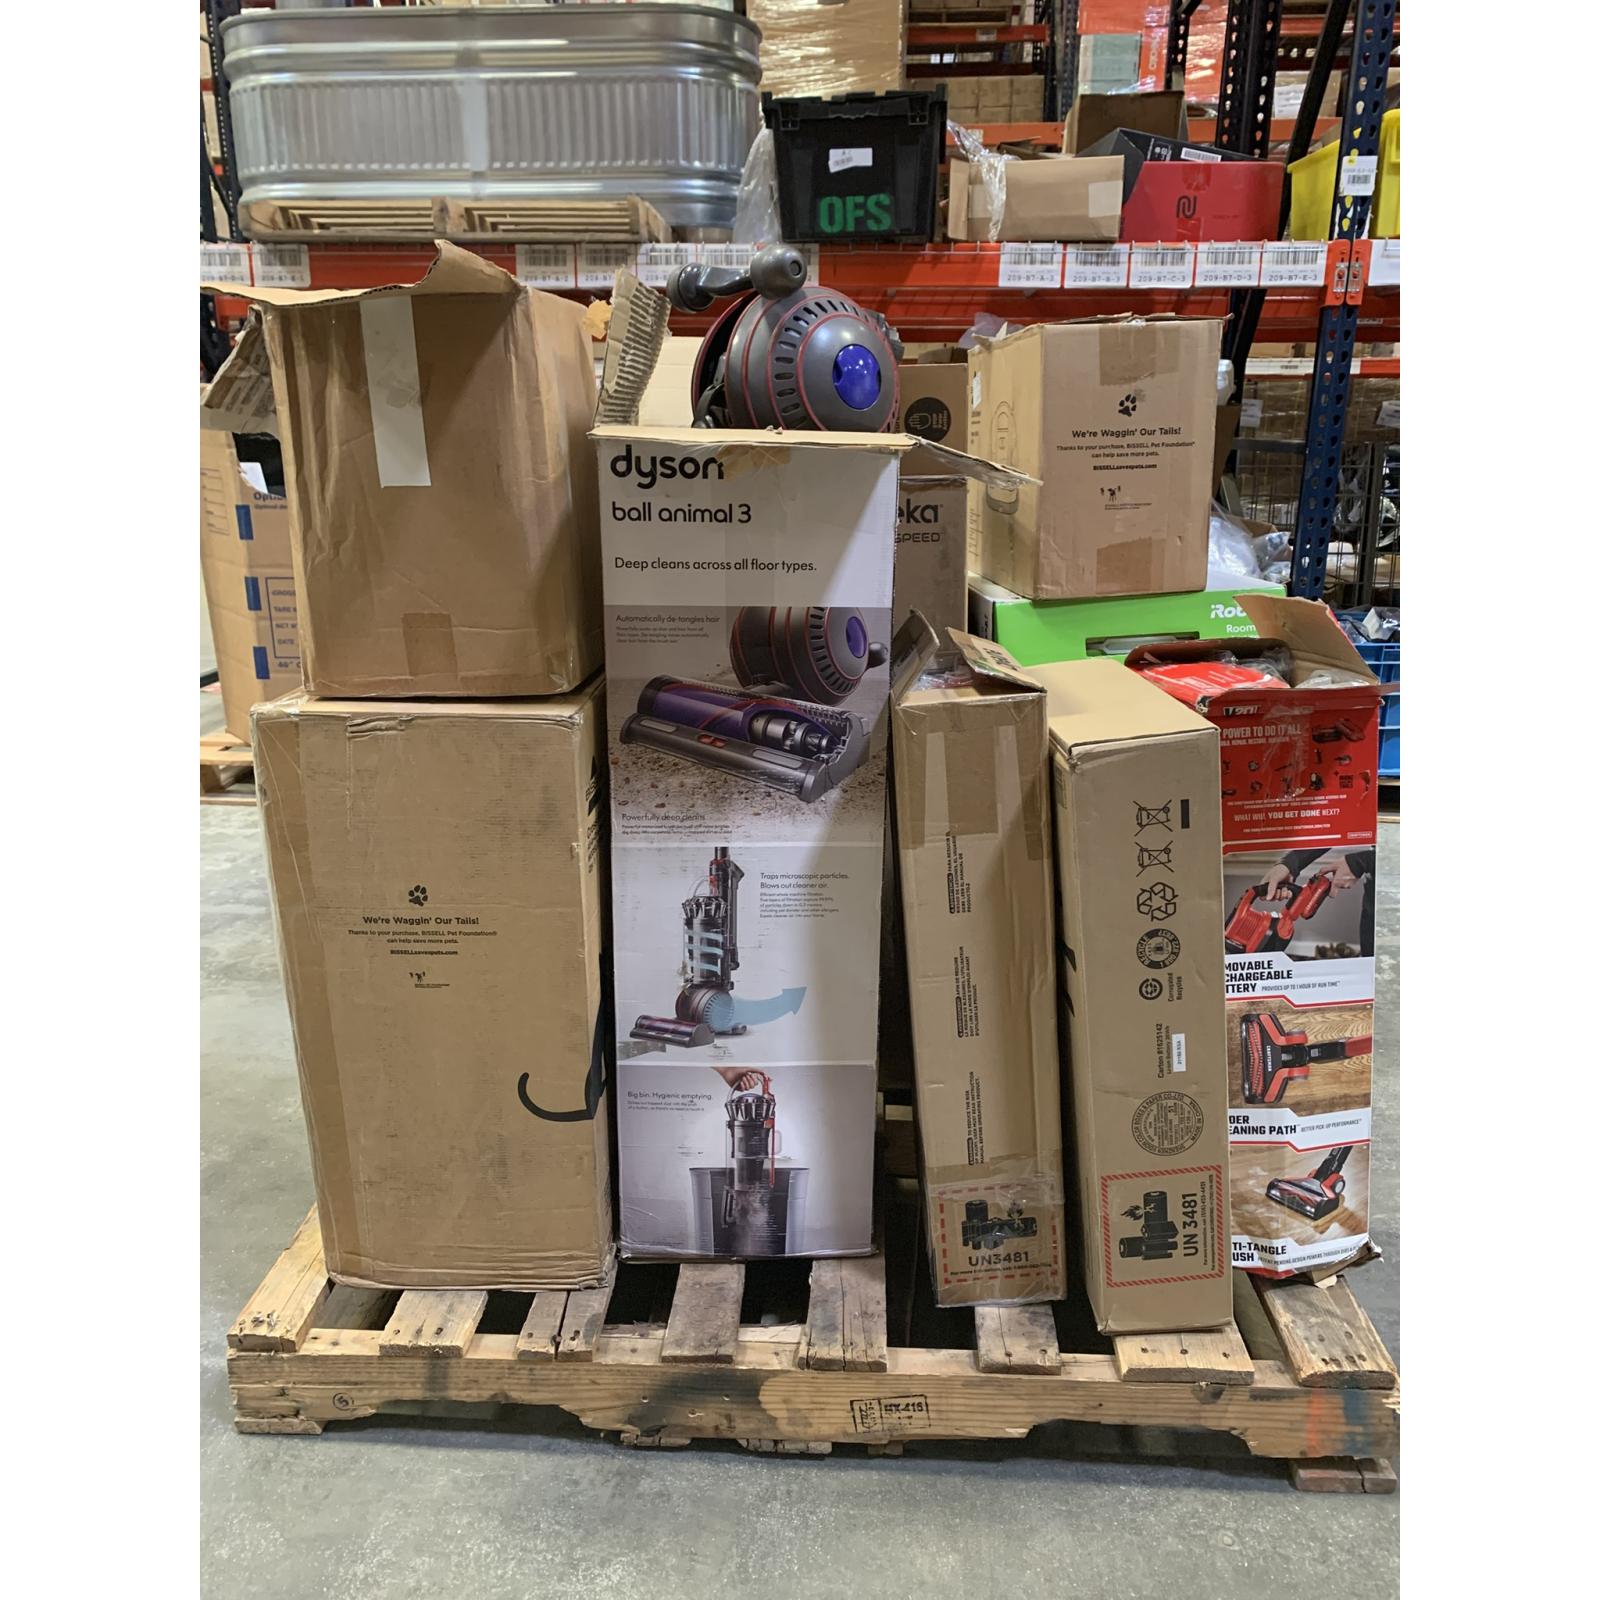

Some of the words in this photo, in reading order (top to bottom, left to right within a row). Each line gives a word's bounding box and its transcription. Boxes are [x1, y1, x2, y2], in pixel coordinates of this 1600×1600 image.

[819, 193, 892, 234] OFS
[1072, 429, 1098, 438] We're
[1100, 428, 1137, 438] Waggin'
[1139, 428, 1156, 436] Our
[1159, 427, 1181, 435] Tails!
[610, 444, 724, 490] dyson
[612, 501, 651, 522] ball
[658, 503, 733, 524] animal
[737, 503, 752, 524] 3
[614, 557, 649, 571] Deep
[651, 558, 691, 571] cleans
[692, 560, 732, 571] across
[733, 559, 748, 571] all
[751, 559, 779, 571] floor
[781, 561, 817, 573] types.
[1223, 727, 1251, 738] POWER
[1253, 727, 1264, 737] TO
[1265, 726, 1276, 736] DO
[1278, 725, 1286, 736] IT
[1287, 724, 1302, 735] ALL
[1234, 813, 1251, 822] WHAT
[1268, 811, 1284, 820] YOU
[1285, 810, 1299, 819] GET
[1300, 809, 1321, 818] DONE
[1322, 808, 1340, 817] NEXT?
[362, 916, 390, 925] We're
[393, 917, 432, 925] Waggin'
[434, 917, 452, 925] Our
[455, 917, 479, 925] Tails!
[652, 1092, 680, 1100] Hygienic
[1182, 1192, 1198, 1229] 3481
[1183, 1233, 1199, 1257] UN
[1233, 1241, 1287, 1256] TI-TANGLE
[968, 1251, 1029, 1267] UN3481
[1232, 1252, 1254, 1262] USH
